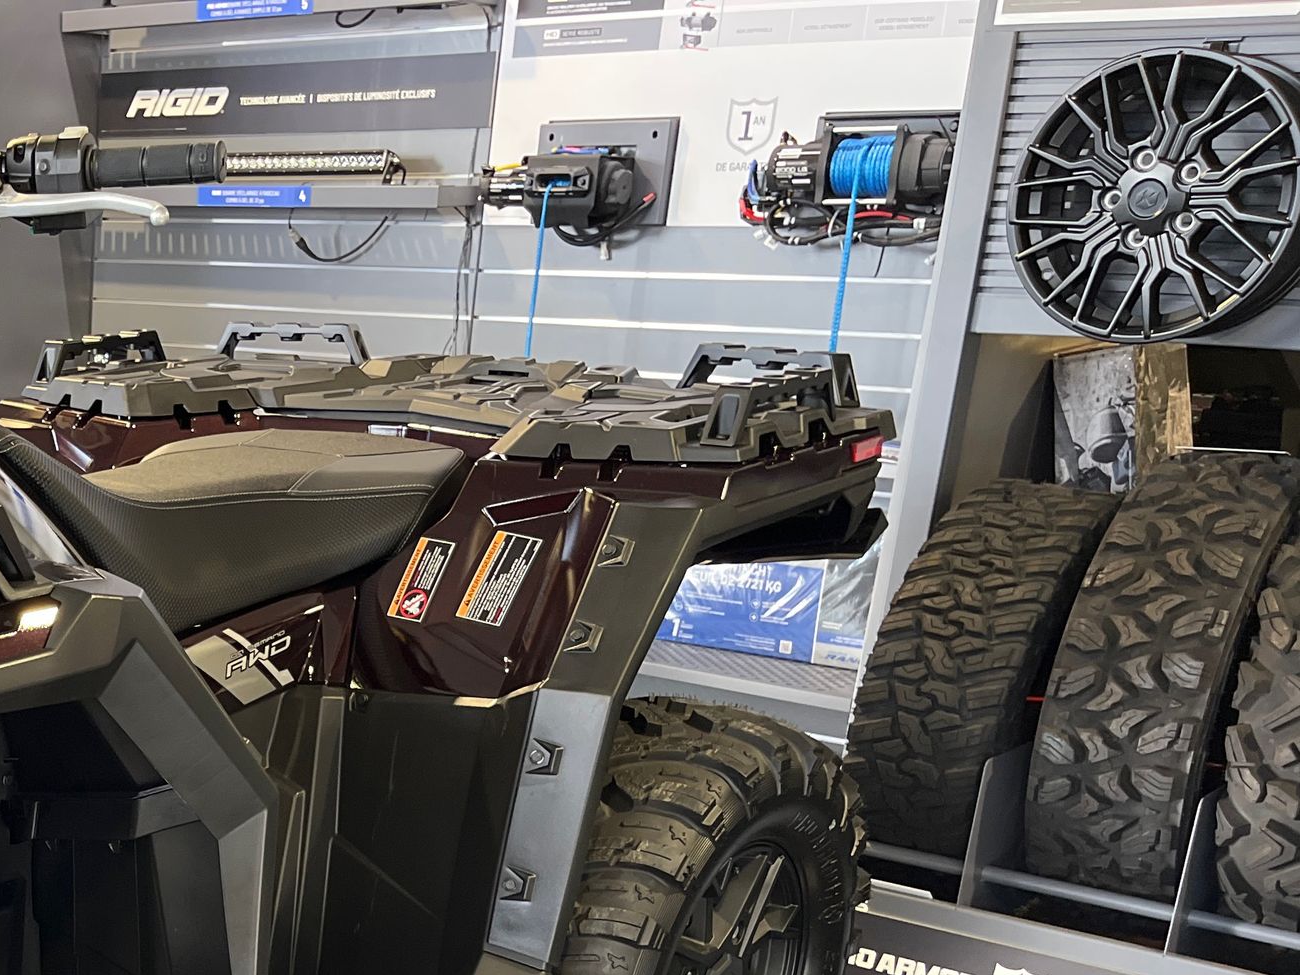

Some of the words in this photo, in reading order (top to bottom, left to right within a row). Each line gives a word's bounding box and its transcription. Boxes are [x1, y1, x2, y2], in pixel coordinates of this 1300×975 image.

[126, 87, 229, 118] RIGID
[738, 110, 753, 141] 1
[753, 115, 766, 125] AN
[716, 162, 727, 172] DE
[299, 189, 307, 202] 4
[468, 540, 500, 598] AVERTISSEMENT
[225, 635, 292, 680] AWD
